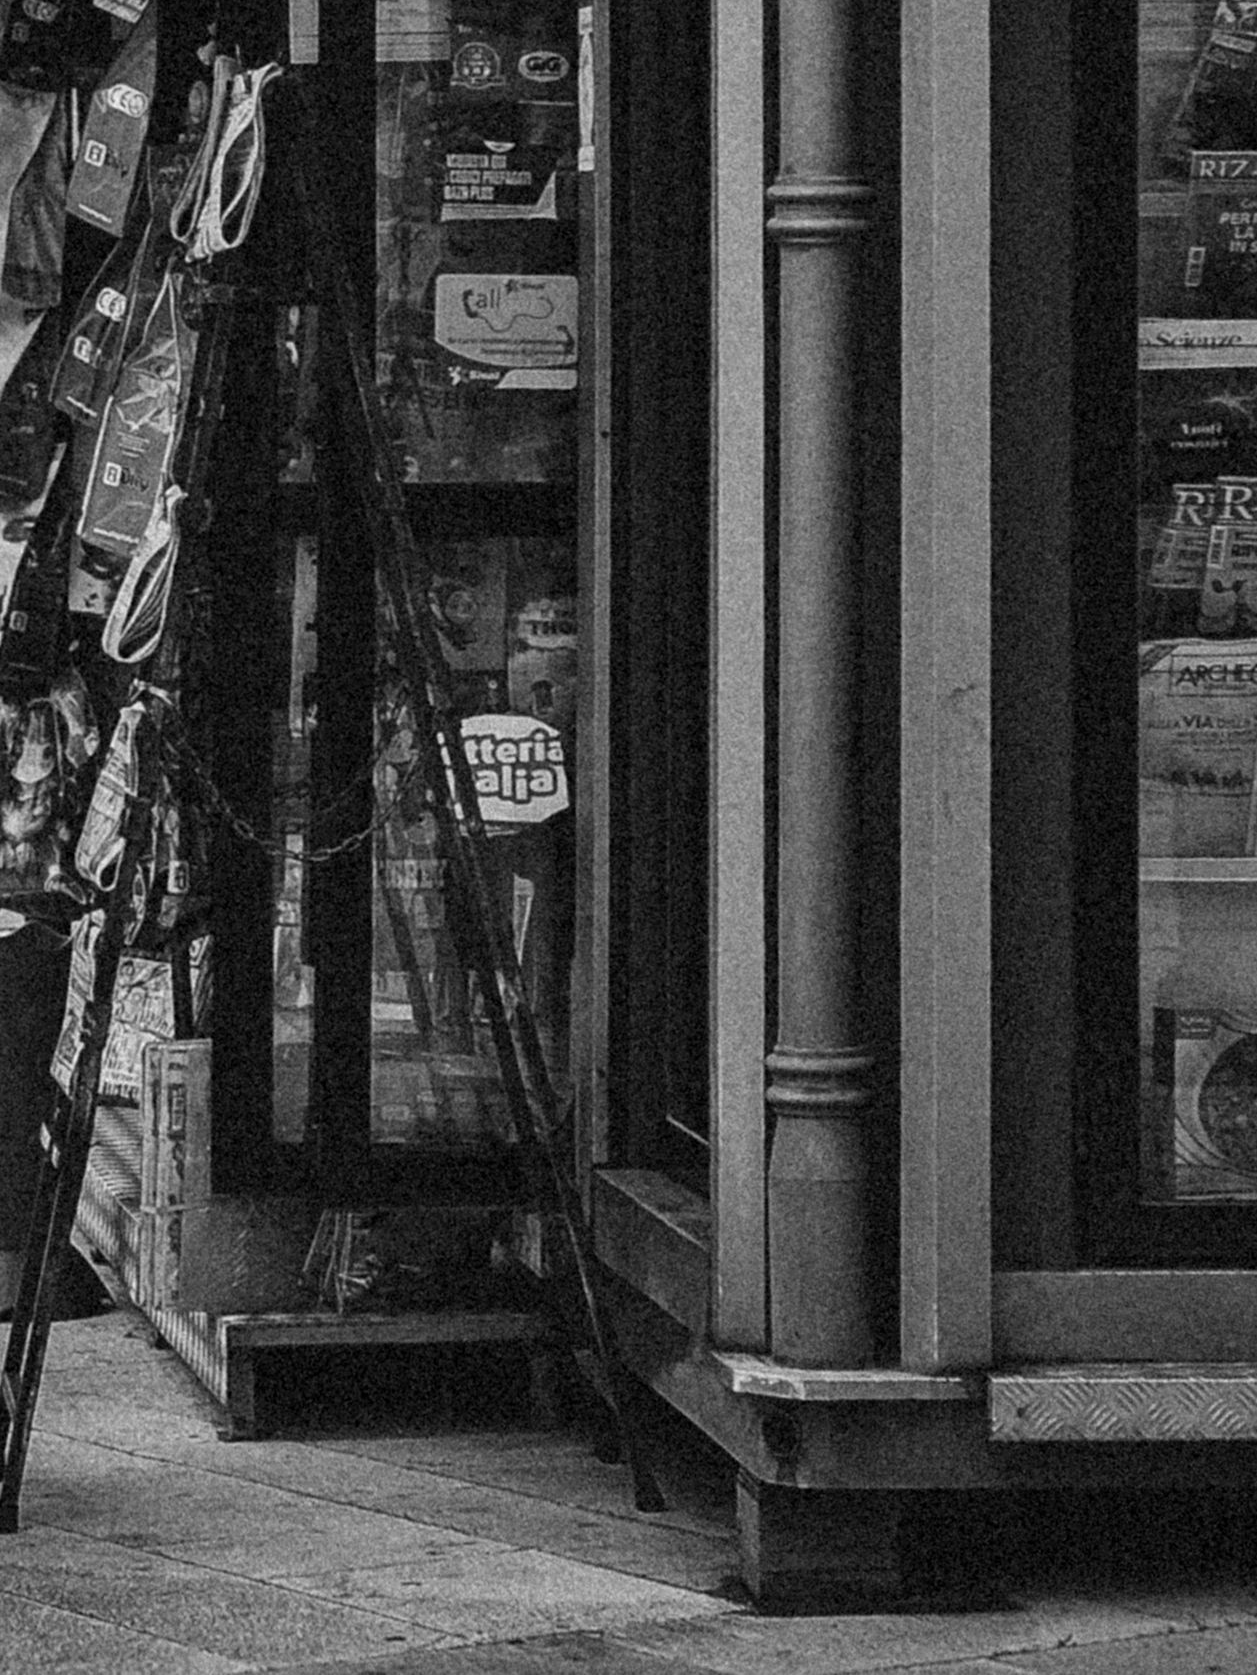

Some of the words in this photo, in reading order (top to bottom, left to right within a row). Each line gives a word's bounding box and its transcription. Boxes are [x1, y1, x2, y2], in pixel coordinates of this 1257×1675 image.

[1200, 159, 1257, 177] RIZ
[464, 730, 565, 765] tteria
[475, 764, 555, 801] alia
